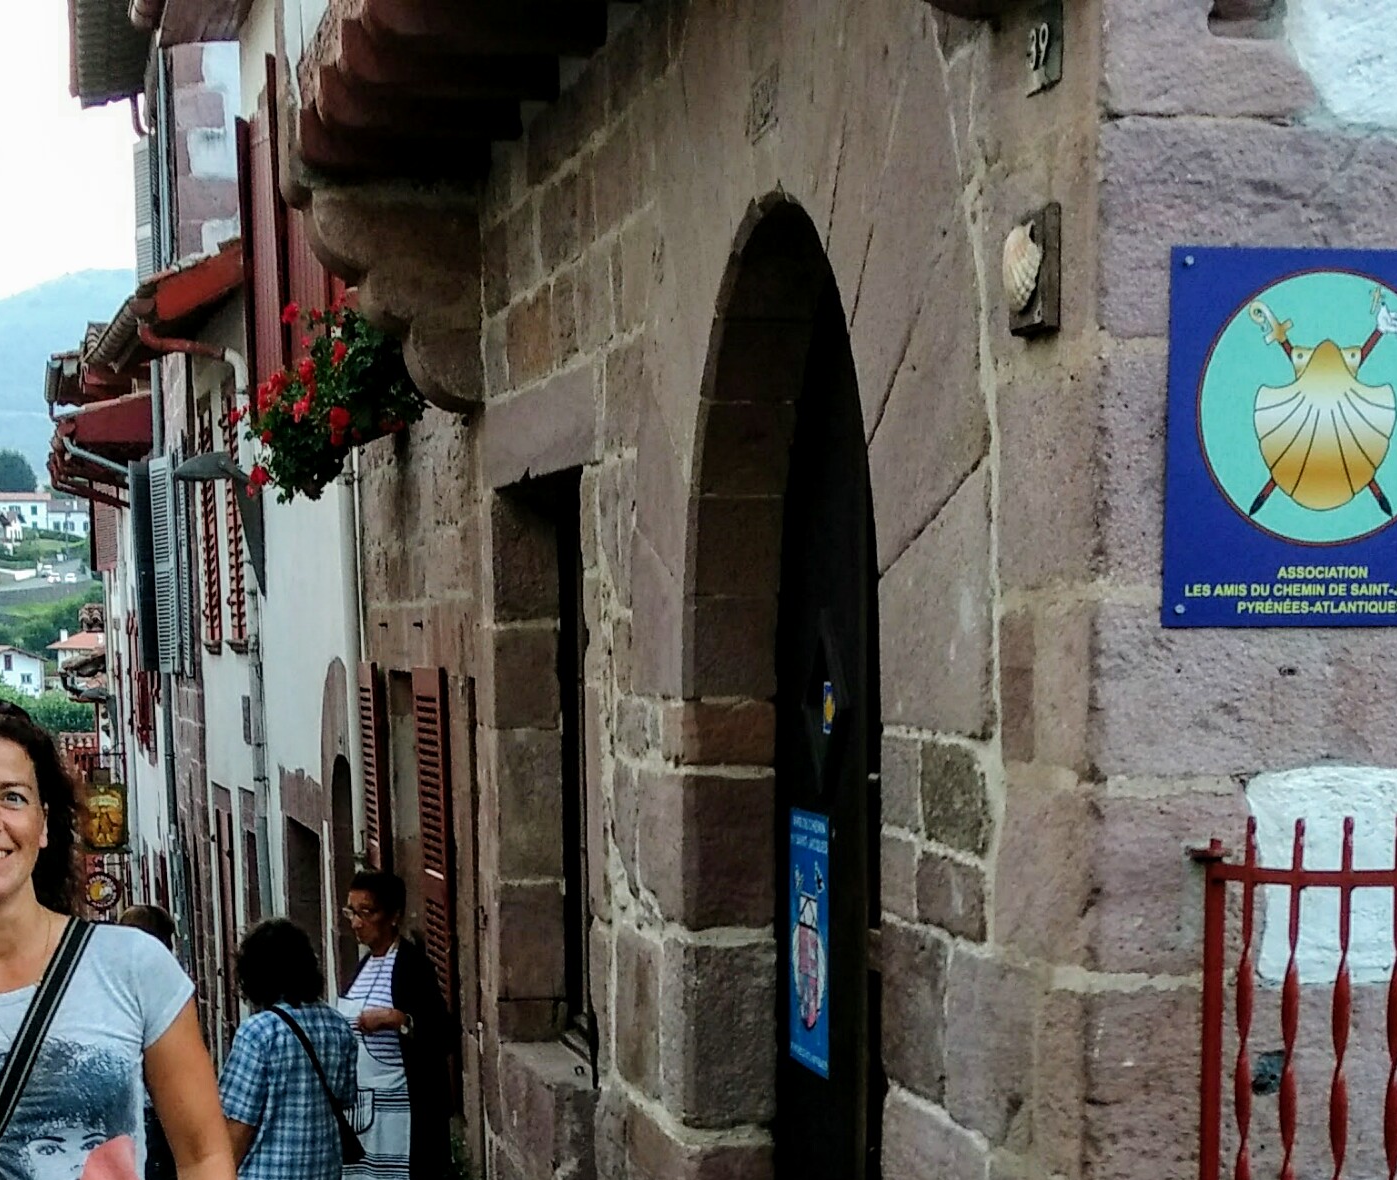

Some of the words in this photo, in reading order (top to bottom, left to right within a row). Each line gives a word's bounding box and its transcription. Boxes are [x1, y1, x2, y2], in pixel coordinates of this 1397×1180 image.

[1028, 22, 1049, 71] 39
[1277, 565, 1369, 579] ASSOCIATION
[1185, 584, 1211, 597] LES
[1213, 584, 1247, 597] AMIS
[1250, 584, 1270, 597] DU
[1273, 584, 1325, 597] CHEMIN
[1329, 584, 1347, 597] DE
